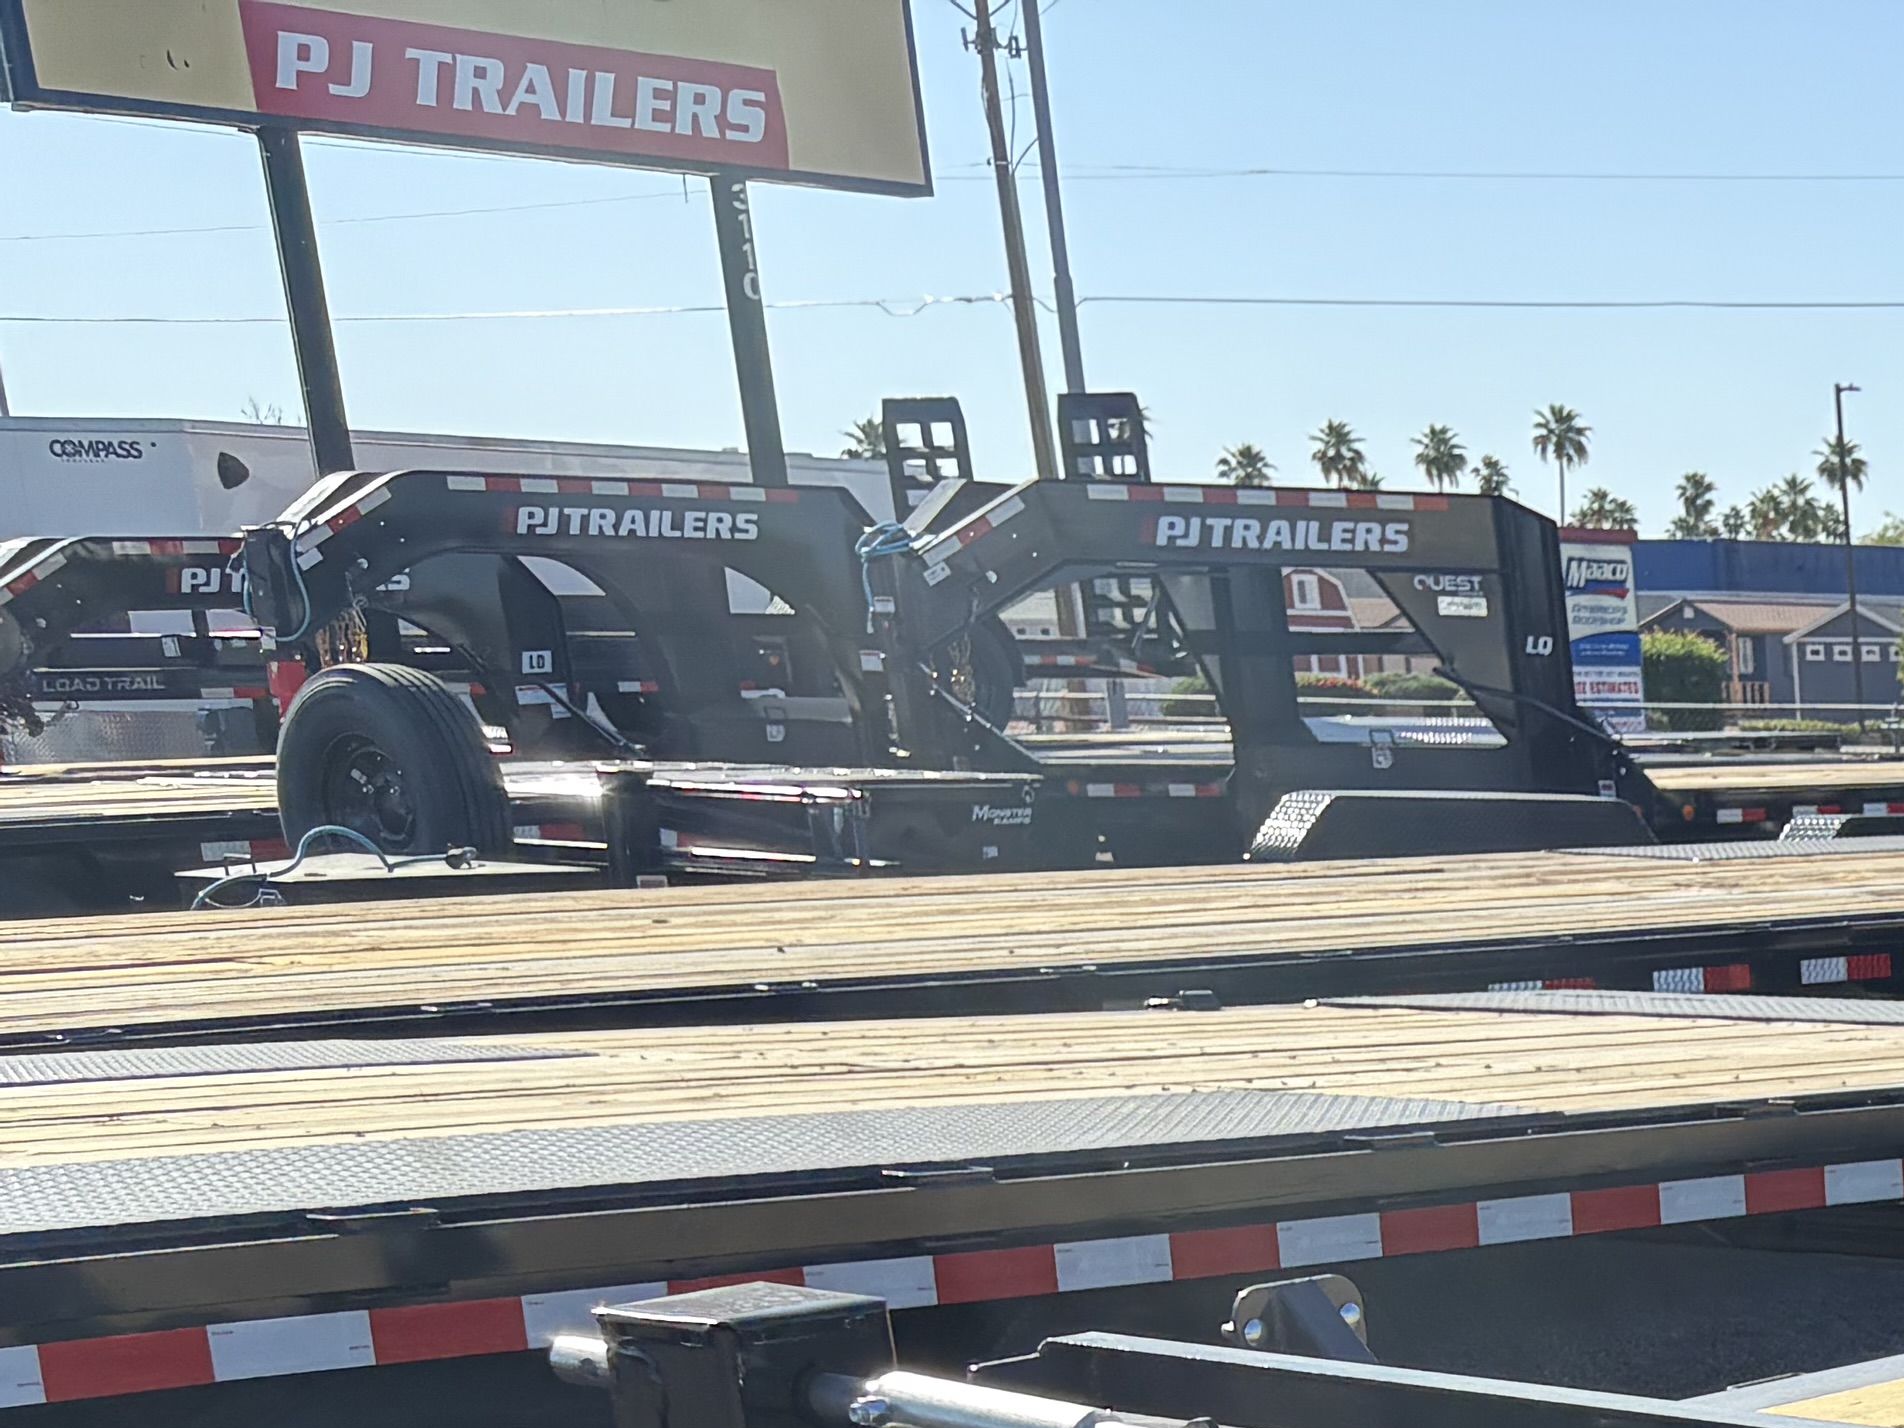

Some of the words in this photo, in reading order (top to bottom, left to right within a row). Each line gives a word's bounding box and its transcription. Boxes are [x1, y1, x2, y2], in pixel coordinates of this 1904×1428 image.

[276, 31, 374, 98] PJ
[404, 47, 767, 143] TRAILERS
[49, 439, 143, 459] COMPASS
[1567, 559, 1629, 588] Maaco
[42, 678, 100, 693] LOAD
[104, 676, 166, 691] TRAIL
